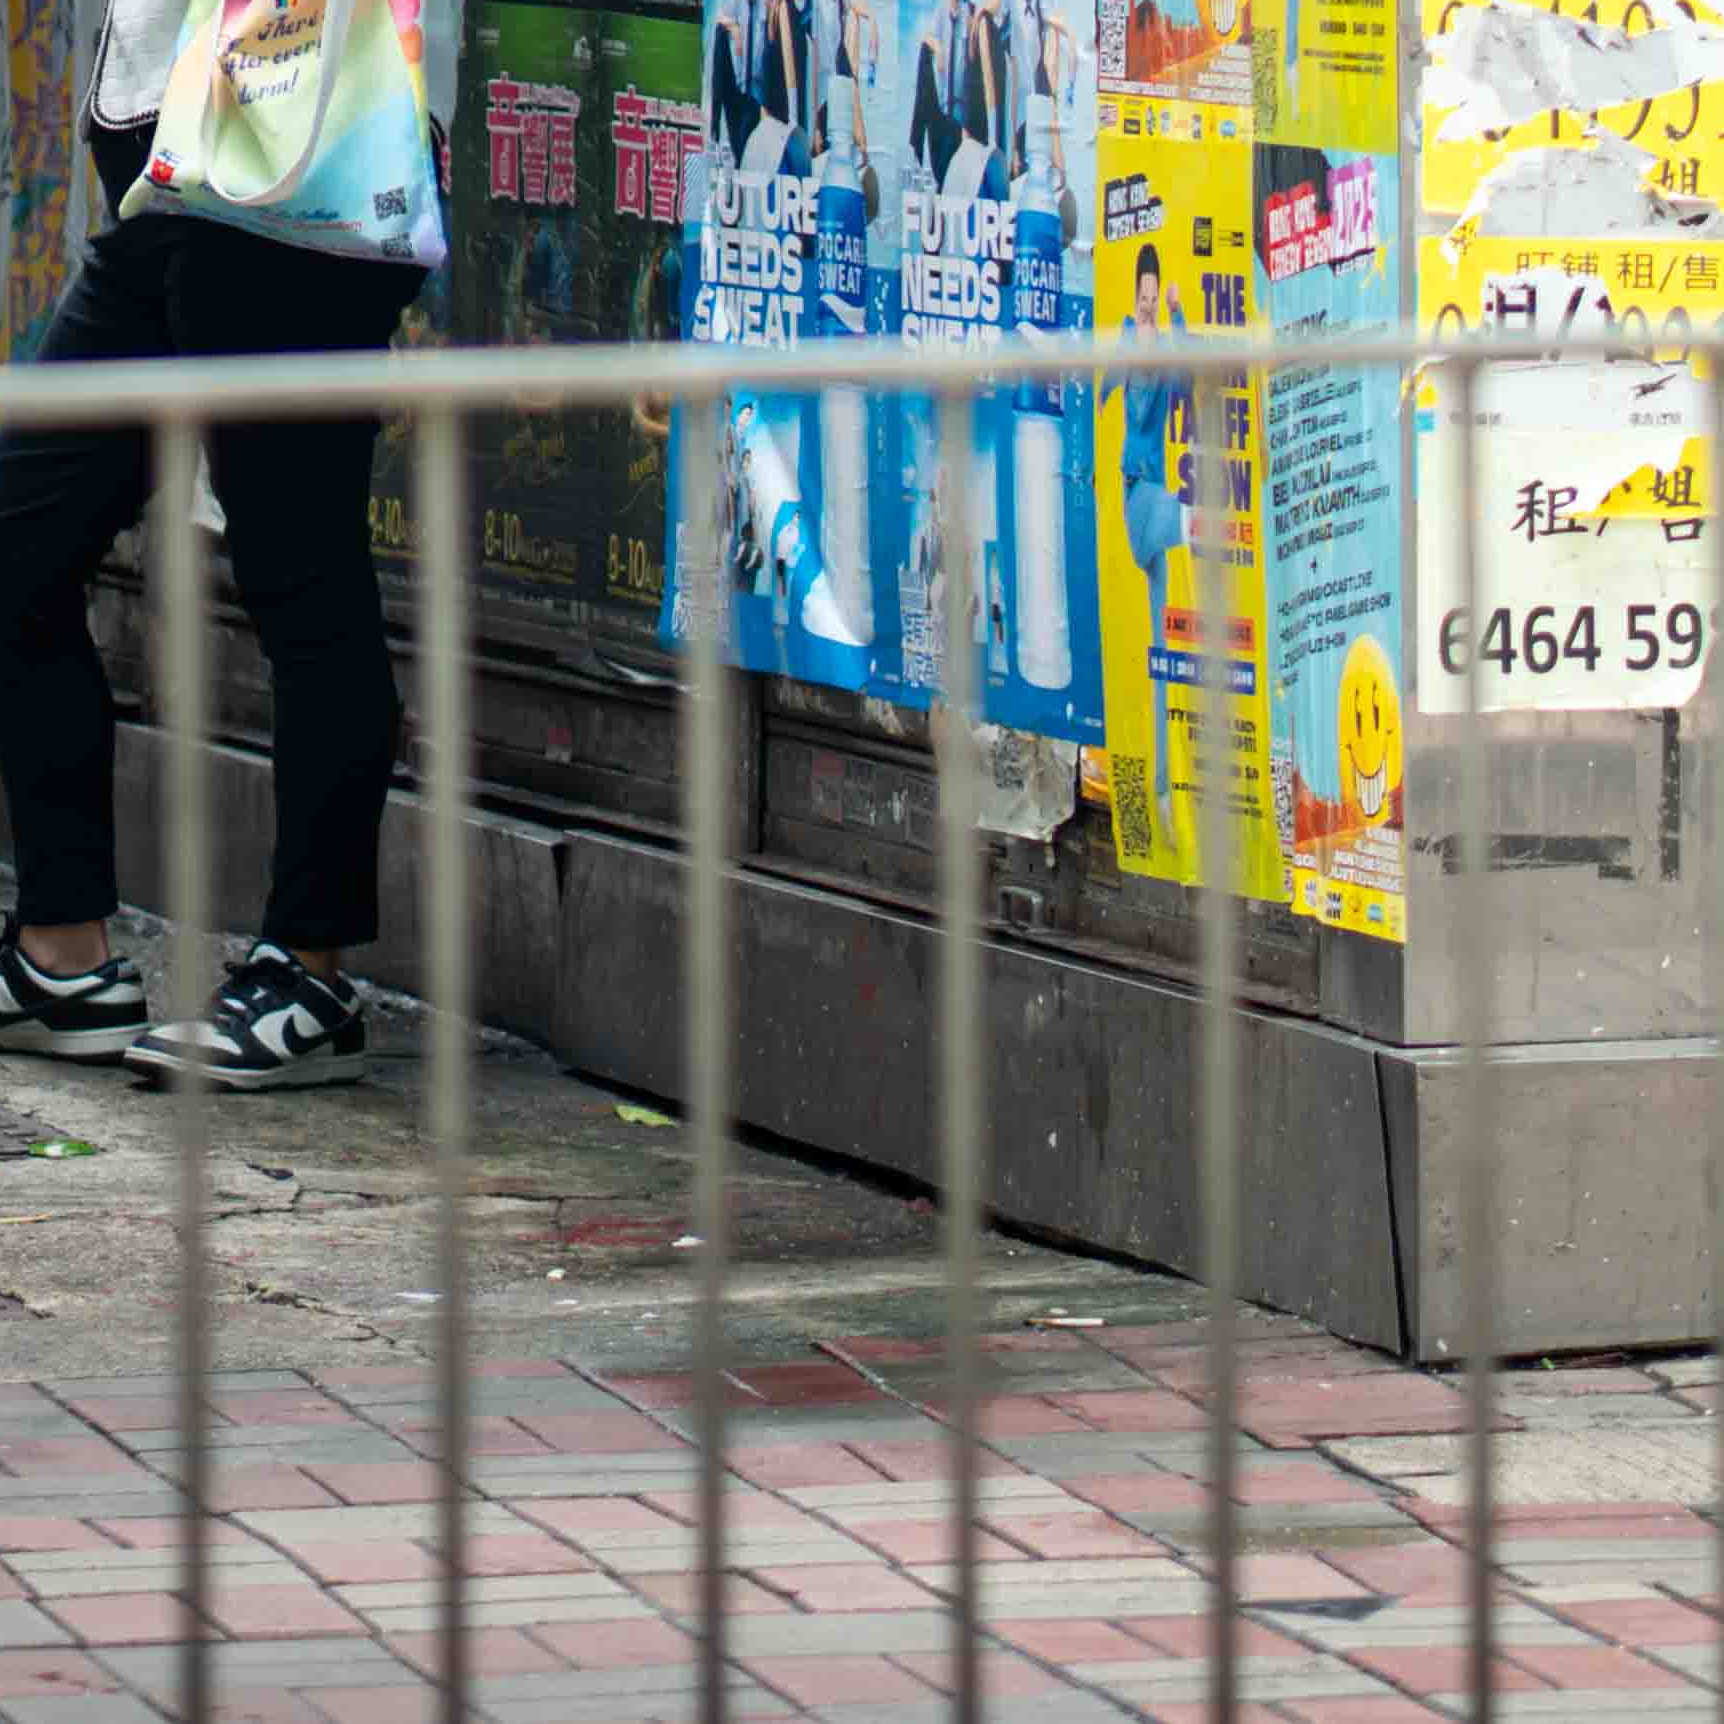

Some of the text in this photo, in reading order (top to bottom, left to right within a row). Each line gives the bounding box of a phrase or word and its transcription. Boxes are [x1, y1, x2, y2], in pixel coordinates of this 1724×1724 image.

[816, 231, 866, 265] POCARI
[900, 195, 1017, 260] FUTURE
[816, 262, 863, 297] SWEAT
[900, 255, 1001, 316] NEEDS
[1013, 256, 1061, 288] POCARI
[1618, 250, 1722, 294] 租/售
[1014, 289, 1057, 324] SWEAT
[1201, 271, 1246, 327] THE
[1651, 464, 1704, 511] 姐
[1438, 600, 1704, 676] 6464 59
